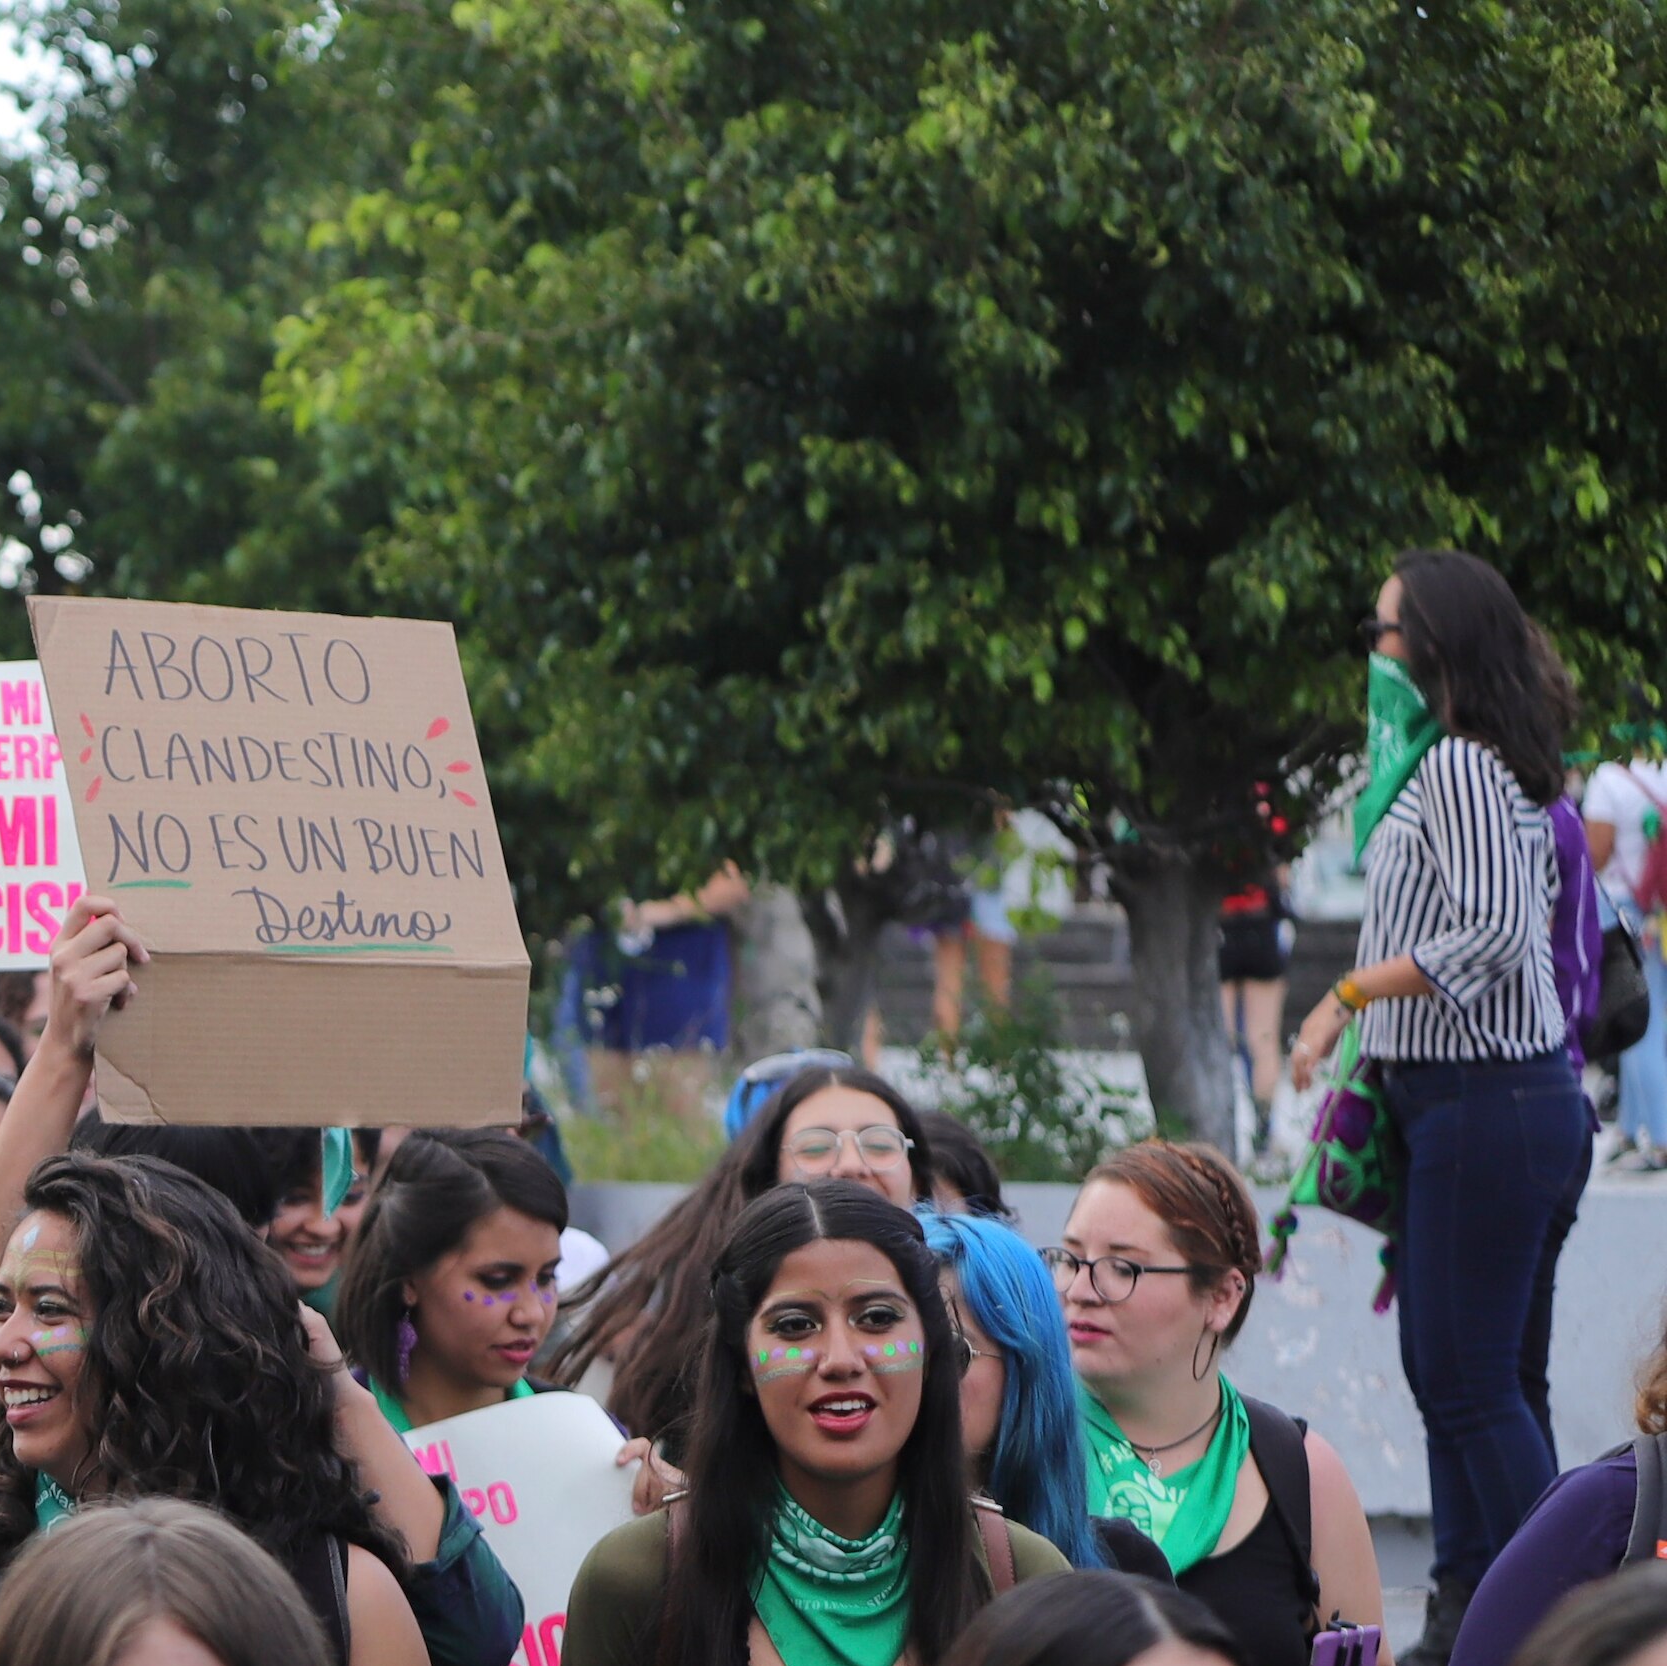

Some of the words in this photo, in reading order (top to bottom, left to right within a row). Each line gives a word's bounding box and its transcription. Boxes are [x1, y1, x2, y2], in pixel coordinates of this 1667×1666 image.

[0, 679, 43, 726] MI
[103, 628, 372, 707] ABORTO
[101, 724, 448, 799] CLANDESTINO,
[106, 810, 193, 884] NO
[207, 813, 269, 872] ES
[277, 815, 348, 875] UN
[352, 817, 486, 880] BUEN
[230, 884, 453, 945] Destino
